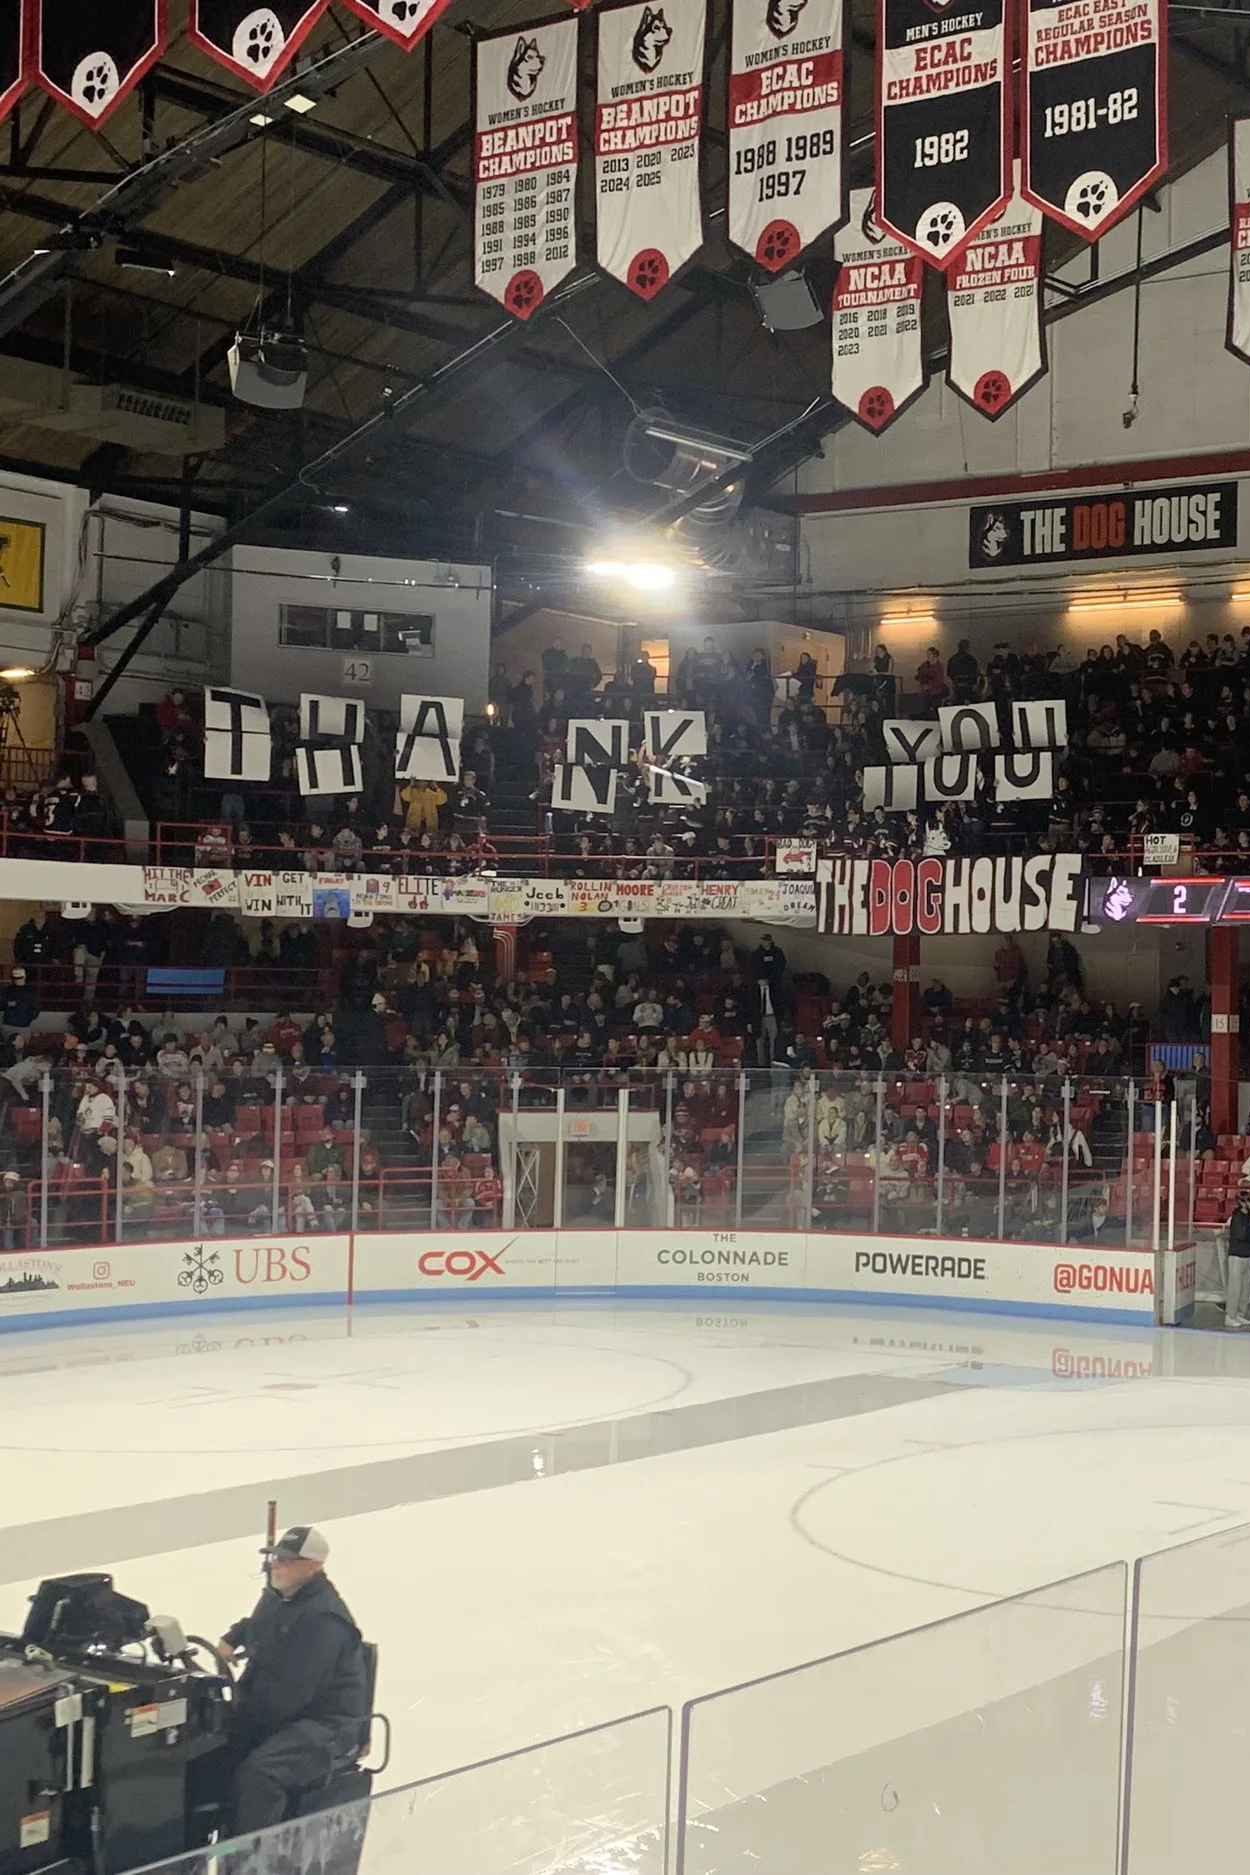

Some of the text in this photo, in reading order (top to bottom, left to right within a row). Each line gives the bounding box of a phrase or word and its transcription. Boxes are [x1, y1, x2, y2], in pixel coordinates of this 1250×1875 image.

[1036, 4, 1148, 43] REGULAR SEASON
[1057, 0, 1126, 23] ECAC EAST
[906, 12, 983, 42] MEN'S HOCKEY
[745, 36, 832, 68] WOMEN'S HOCKEY
[914, 38, 972, 72] ECAC
[1035, 19, 1152, 67] CHAMPIONS
[611, 71, 694, 99] WOMEN'S HOCKEY
[760, 61, 815, 96] ECAC
[887, 59, 998, 101] CHAMPIONS
[488, 98, 566, 125] WOMEN'S HOCKEY
[601, 90, 699, 130] BEANPOT
[734, 82, 839, 124] CHAMPIONS
[1044, 88, 1138, 138] 1981-82
[480, 116, 572, 157] BEANPOT
[600, 115, 699, 152] CHAMPIONS
[478, 142, 573, 179] CHAMPIONS
[602, 143, 695, 175] 2013 2020 2023
[735, 130, 835, 175] 1988 1989
[914, 130, 969, 168] 1982
[482, 169, 570, 200] 1979 1980 1984
[600, 170, 662, 193] 2024 2025
[758, 170, 807, 202] 1997
[482, 188, 570, 218] 1985 1986 1987
[513, 214, 536, 231] 1989
[545, 207, 569, 224] 1990
[1001, 222, 1032, 237] HOCKEY
[482, 226, 569, 255] 1991 1994 1996
[481, 244, 569, 274] 1997 1998 2012
[842, 249, 882, 263] WOMEN'S
[965, 242, 1025, 272] NCAA
[849, 263, 907, 291] NCAA
[956, 265, 1035, 290] FROZEN FOUR
[837, 283, 918, 309] TOURNAMENT
[954, 289, 1006, 307] 2021 2022
[839, 304, 915, 325] 2016 2018 2019
[838, 320, 917, 341] 2020 2021 2022
[838, 343, 860, 356] 2023
[1020, 493, 1221, 556] THE DOG HOUSE
[345, 663, 369, 681] 42
[1146, 836, 1166, 845] HOT
[282, 873, 305, 883] GET
[398, 878, 439, 896] ELITE
[570, 881, 612, 892] ROLLIN
[616, 884, 655, 896] MOORE
[701, 884, 737, 895] HENRY
[571, 891, 609, 901] NOLAN
[579, 902, 588, 912] 3
[1173, 885, 1187, 914] 2
[1215, 1017, 1225, 1029] 15
[713, 1233, 737, 1243] THE
[233, 1246, 312, 1284] UBS
[417, 1248, 507, 1281] COX
[657, 1249, 789, 1267] COLONNADE
[855, 1251, 986, 1280] POWERADE
[697, 1272, 749, 1282] BOSTON
